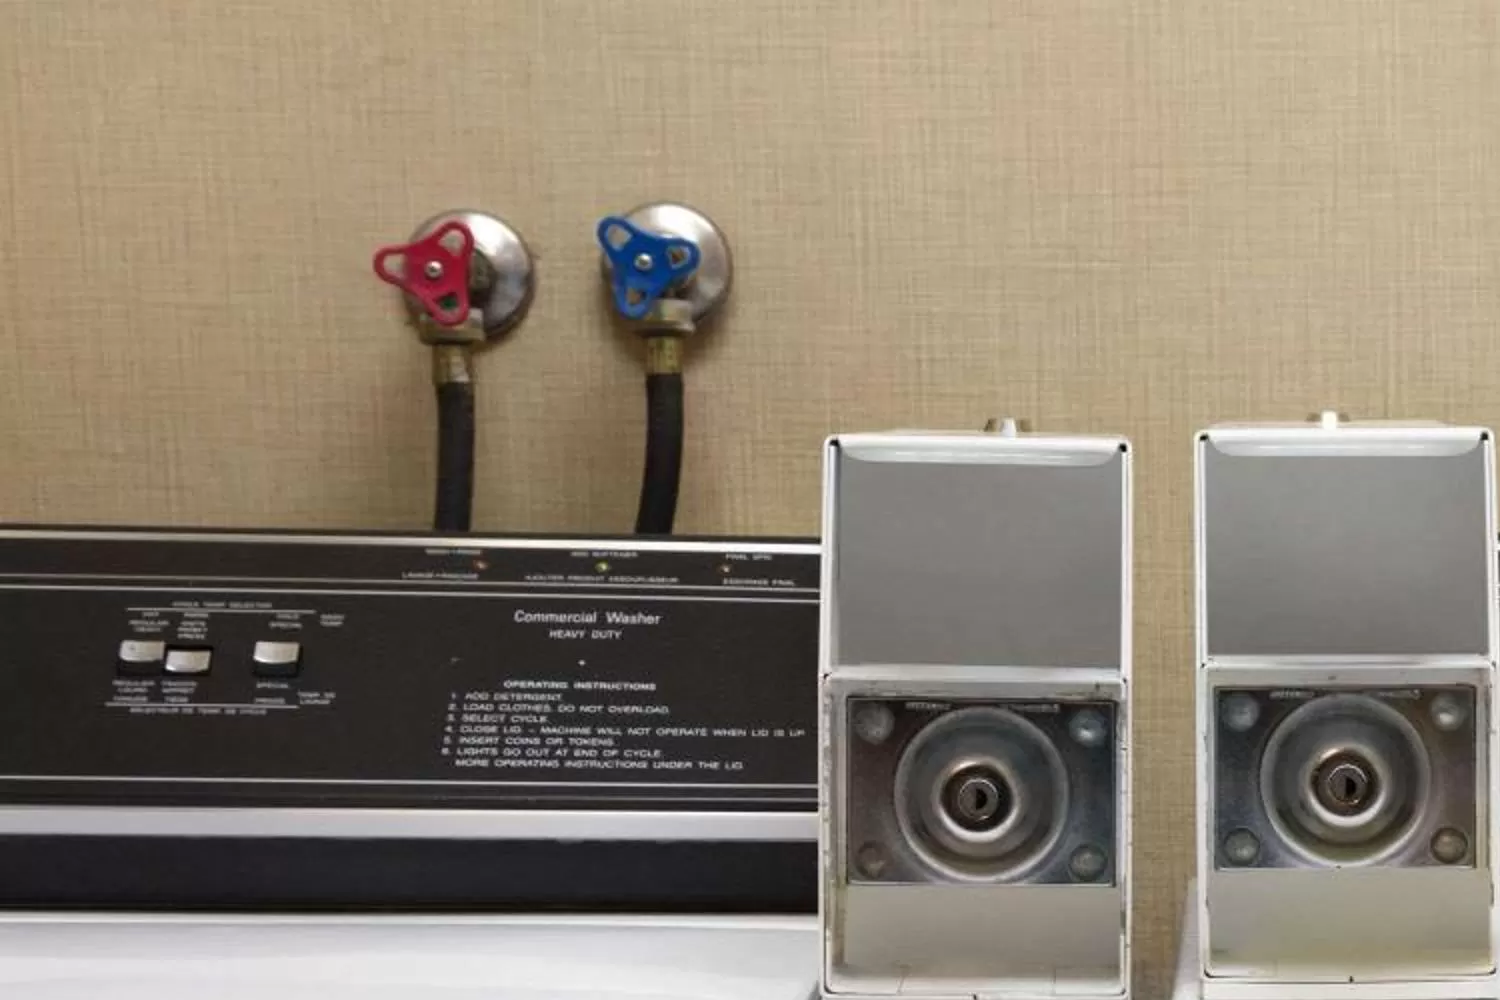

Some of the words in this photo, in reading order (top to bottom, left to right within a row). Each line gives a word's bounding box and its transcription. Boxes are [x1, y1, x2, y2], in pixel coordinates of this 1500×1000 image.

[513, 609, 598, 623] Commercial
[605, 611, 663, 625] Washer
[549, 629, 586, 639] HEAVY
[591, 629, 623, 639] DUTY
[503, 680, 569, 689] OPERATING
[573, 681, 657, 691] INSTRUCTIONS
[463, 704, 495, 712] LOAD
[557, 705, 576, 713] DO
[461, 714, 506, 722] SELECT
[459, 726, 499, 734] CLOSE
[540, 727, 592, 735] MACHINE
[597, 728, 623, 736] WILL
[627, 728, 651, 736] NOT
[655, 728, 708, 736] OPERATE
[713, 729, 747, 737] WHEN
[458, 736, 500, 744] INSERT
[505, 737, 541, 745] COINS
[545, 737, 564, 745] OR
[456, 747, 498, 756] LIGHTS
[502, 748, 521, 756] GO
[525, 748, 550, 757] OUT
[555, 749, 569, 757] AT
[573, 749, 598, 757] END
[455, 758, 489, 767] MORE
[494, 759, 560, 767] OPERATING
[564, 760, 649, 769] INSTRUCTIONS
[653, 761, 693, 769] UNDER
[697, 761, 720, 769] THE
